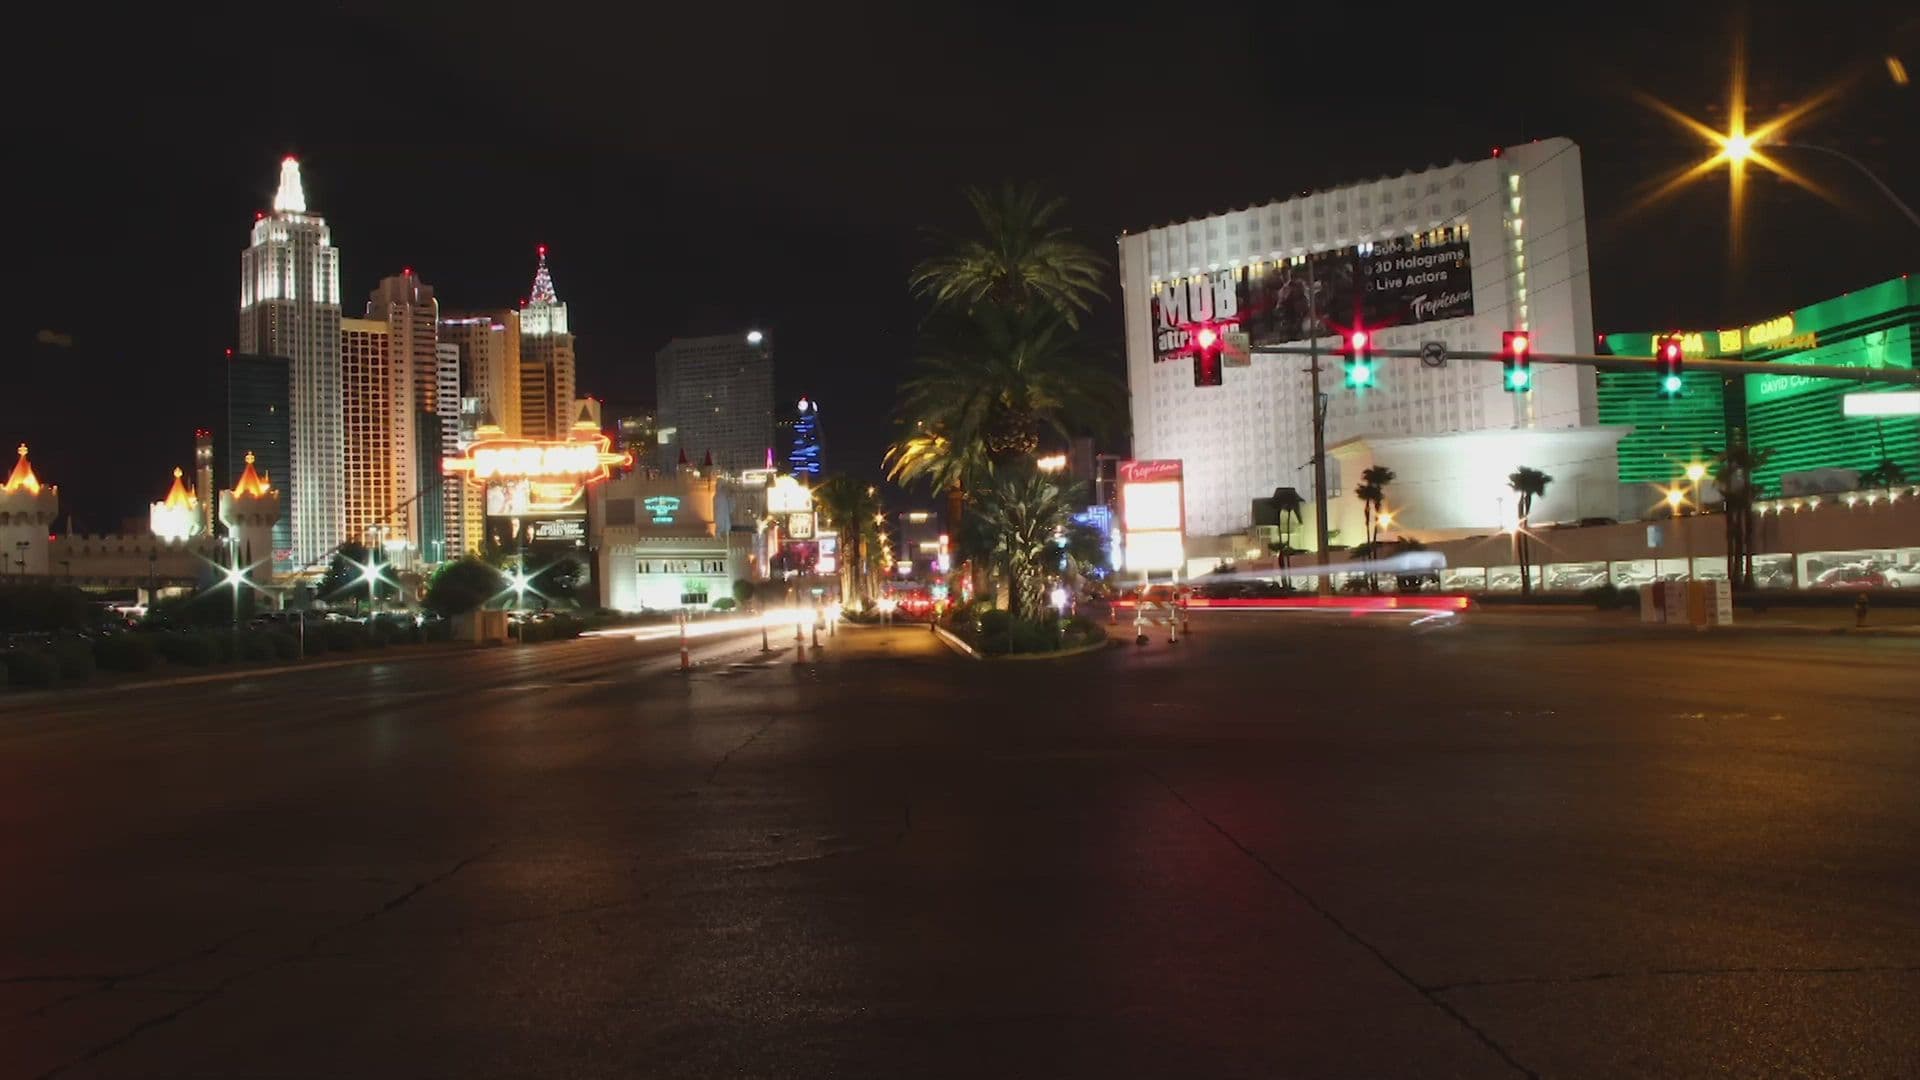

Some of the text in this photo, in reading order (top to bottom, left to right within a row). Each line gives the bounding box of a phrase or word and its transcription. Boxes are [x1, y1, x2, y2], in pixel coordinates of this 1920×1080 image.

[1375, 249, 1465, 274] 3D Holograms
[1377, 271, 1447, 290] Live Actors
[1410, 291, 1471, 320] Tropicana
[1760, 377, 1788, 394] DAVID
[1120, 461, 1179, 481] Tropicana
